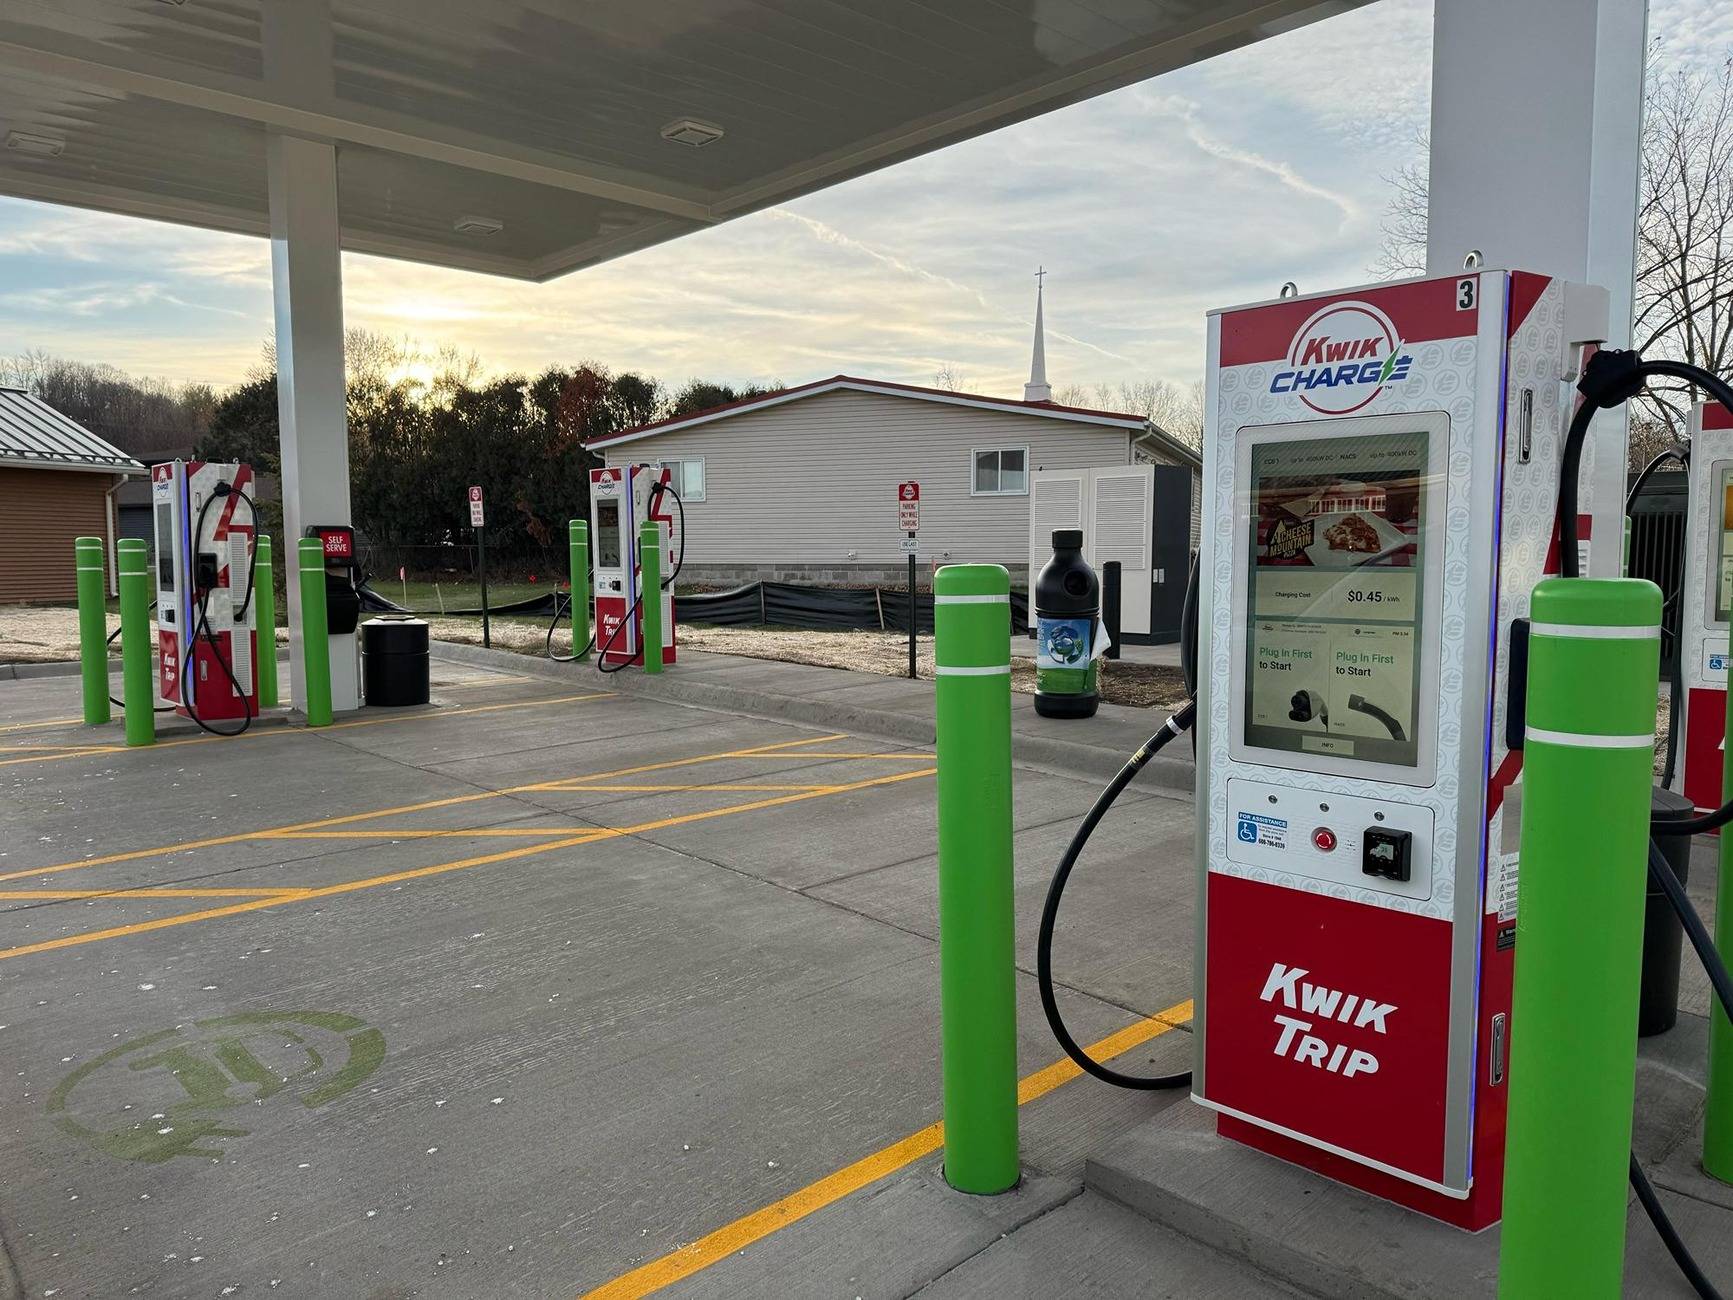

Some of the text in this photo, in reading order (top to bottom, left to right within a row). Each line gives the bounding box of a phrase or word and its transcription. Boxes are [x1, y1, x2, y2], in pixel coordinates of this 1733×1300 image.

[1459, 280, 1474, 309] 3
[1300, 335, 1384, 366] KWIK
[1269, 354, 1414, 394] CHARGE
[328, 536, 343, 544] SELF
[326, 544, 347, 552] SERVE
[1275, 591, 1298, 599] Charging
[1348, 590, 1382, 602] $0.45
[1259, 647, 1312, 659] Plug In First
[1336, 652, 1394, 664] Plug In First
[1259, 661, 1292, 671] to Start
[1336, 666, 1371, 677] to Start
[1252, 816, 1287, 827] ASSISTANCE
[1260, 962, 1399, 1034] KWIK
[1273, 1014, 1380, 1078] TRIP
